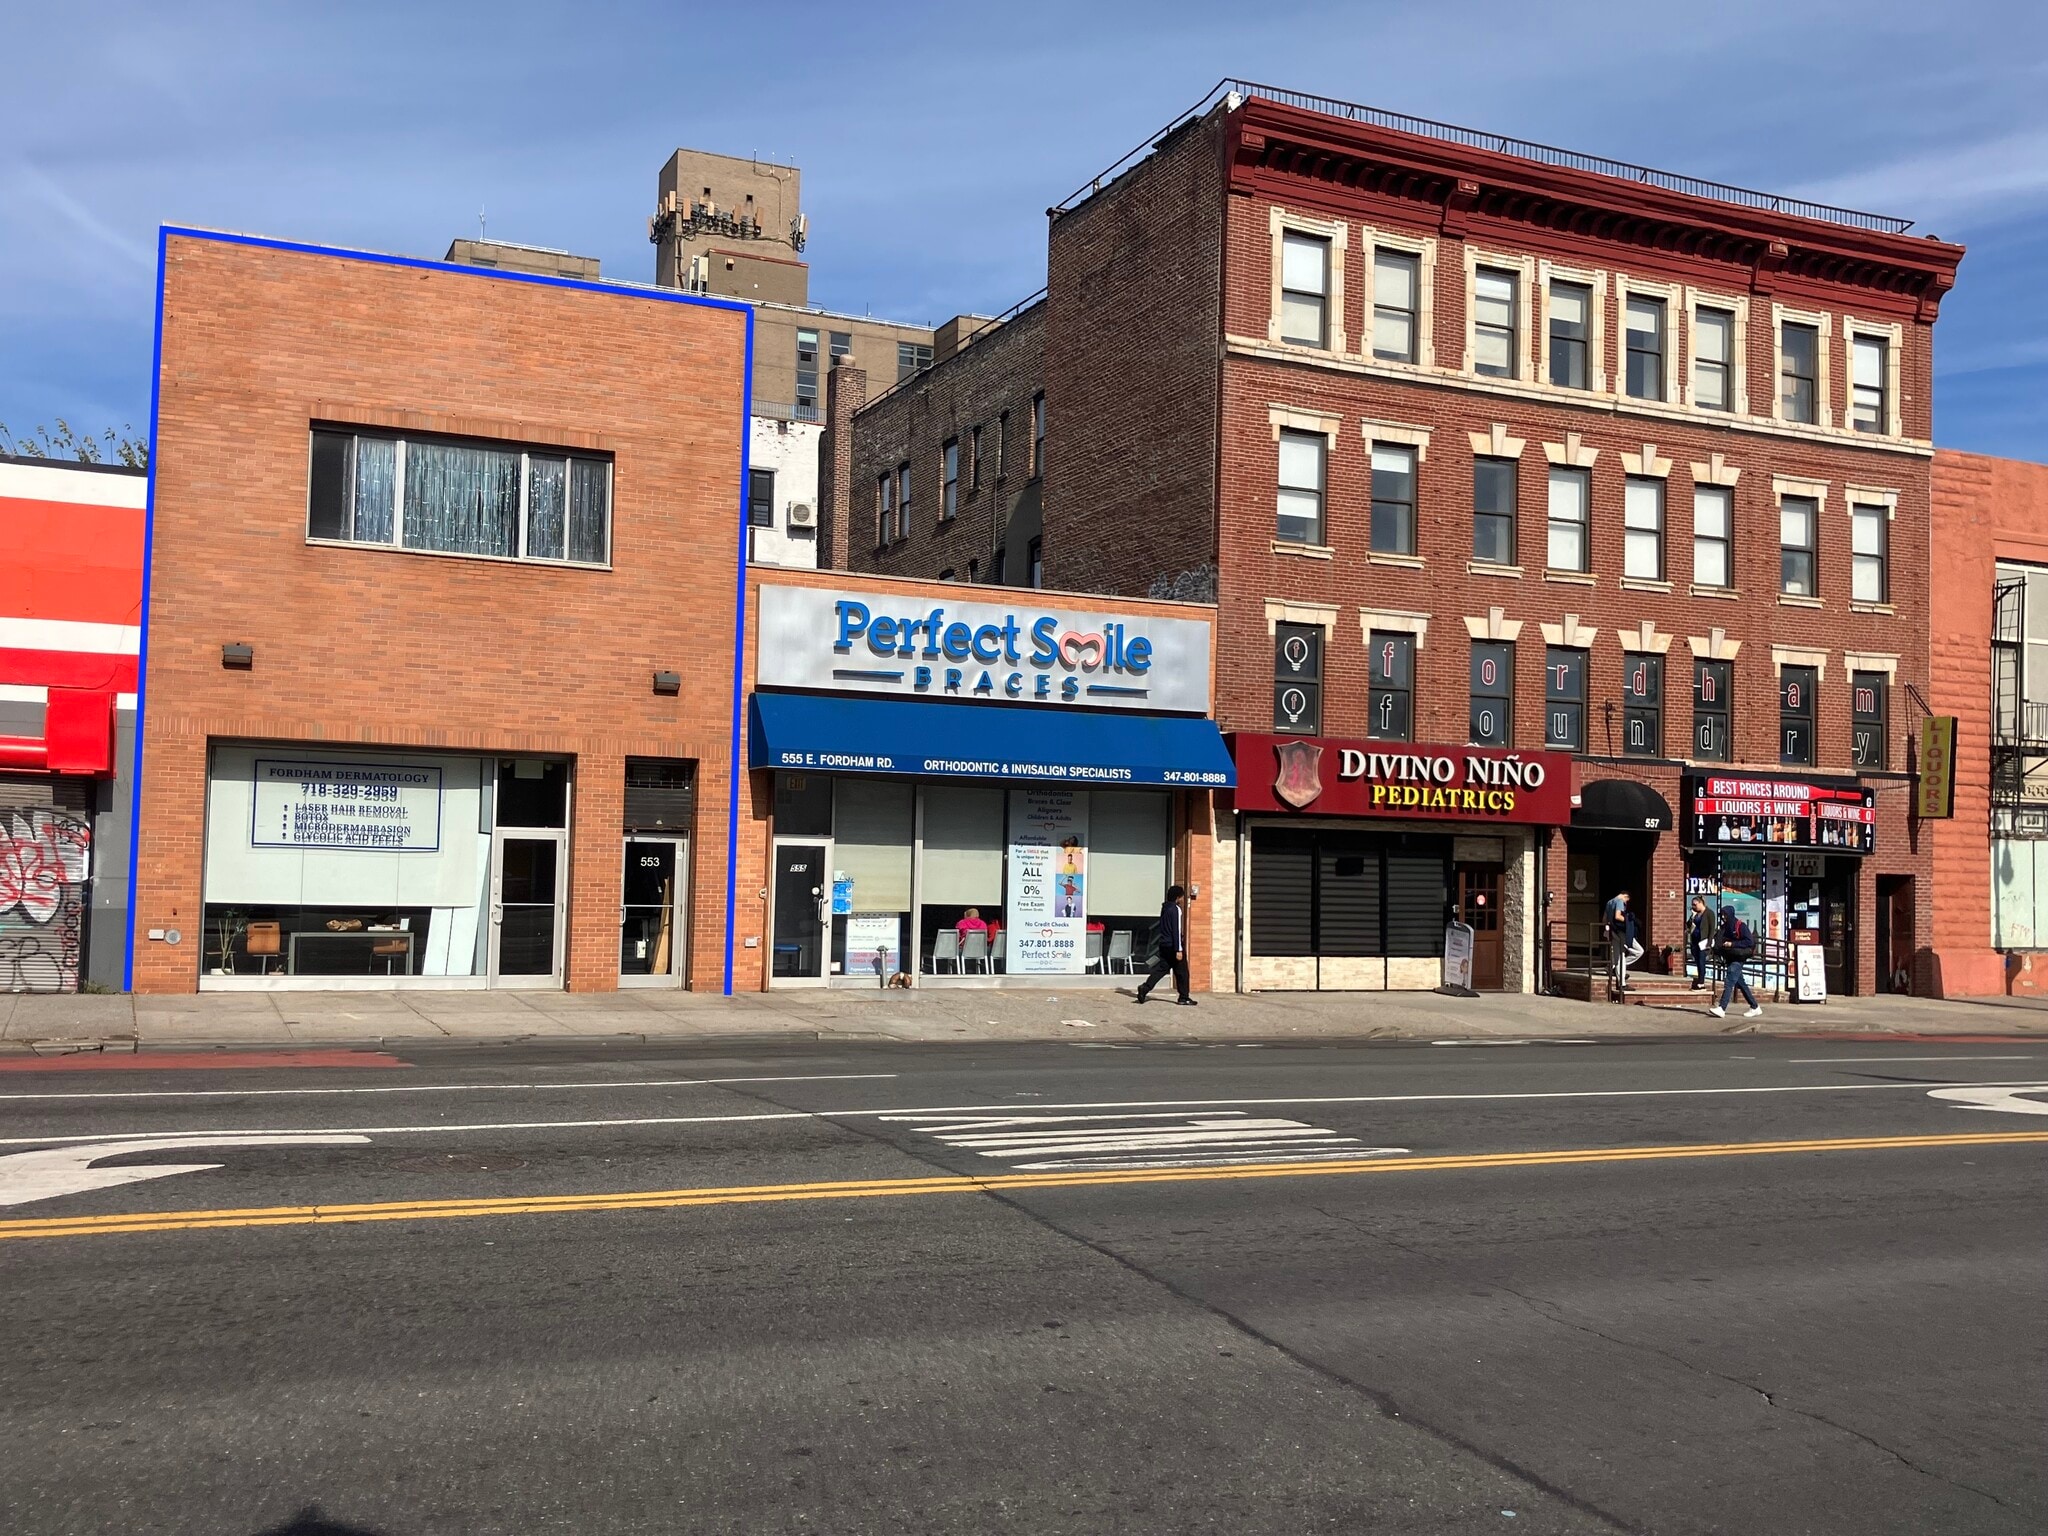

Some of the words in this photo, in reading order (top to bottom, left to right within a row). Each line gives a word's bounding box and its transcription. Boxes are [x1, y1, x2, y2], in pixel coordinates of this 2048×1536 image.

[835, 600, 1021, 660] Perfect
[914, 667, 1080, 696] BRACES
[781, 753, 803, 765] 555
[806, 754, 817, 765] E.
[820, 755, 874, 768] FORDHAM
[877, 758, 895, 769] RD.
[1340, 749, 1455, 783] DIVINO
[1467, 754, 1545, 787] NIÑO
[1925, 720, 1942, 813] LIQUORS
[269, 768, 332, 779] FORDHAM
[336, 771, 429, 783] DERMATOLOGY
[923, 759, 999, 773] ORTHODONTIC
[1001, 764, 1009, 774] &
[1011, 764, 1067, 776] INVISALIGN
[1069, 767, 1132, 780] SPECIALISTS
[1163, 771, 1227, 784] 347-801-8888
[301, 783, 398, 799] 718-329-2959
[1713, 781, 1737, 795] BEST
[1739, 782, 1771, 796] PRICES
[1773, 784, 1810, 799] AROUND
[1373, 785, 1515, 810] PEDIATRICS
[295, 803, 328, 812] LASER
[331, 804, 356, 813] HAIR
[359, 805, 408, 815] REMOVAL
[1716, 801, 1760, 814] LIQUORS
[1763, 802, 1771, 814] &
[1773, 802, 1802, 815] WINE
[1820, 804, 1843, 818] LIQUORS
[1847, 807, 1860, 820] WINE
[295, 812, 329, 821] BOTOX
[1645, 818, 1660, 828] 557
[345, 833, 369, 842] ACID
[640, 857, 660, 867] 553
[1022, 867, 1043, 877] ALL
[1023, 885, 1041, 895] 0%
[1019, 940, 1075, 948] 347.801.8888
[1021, 950, 1050, 959] Perfect
